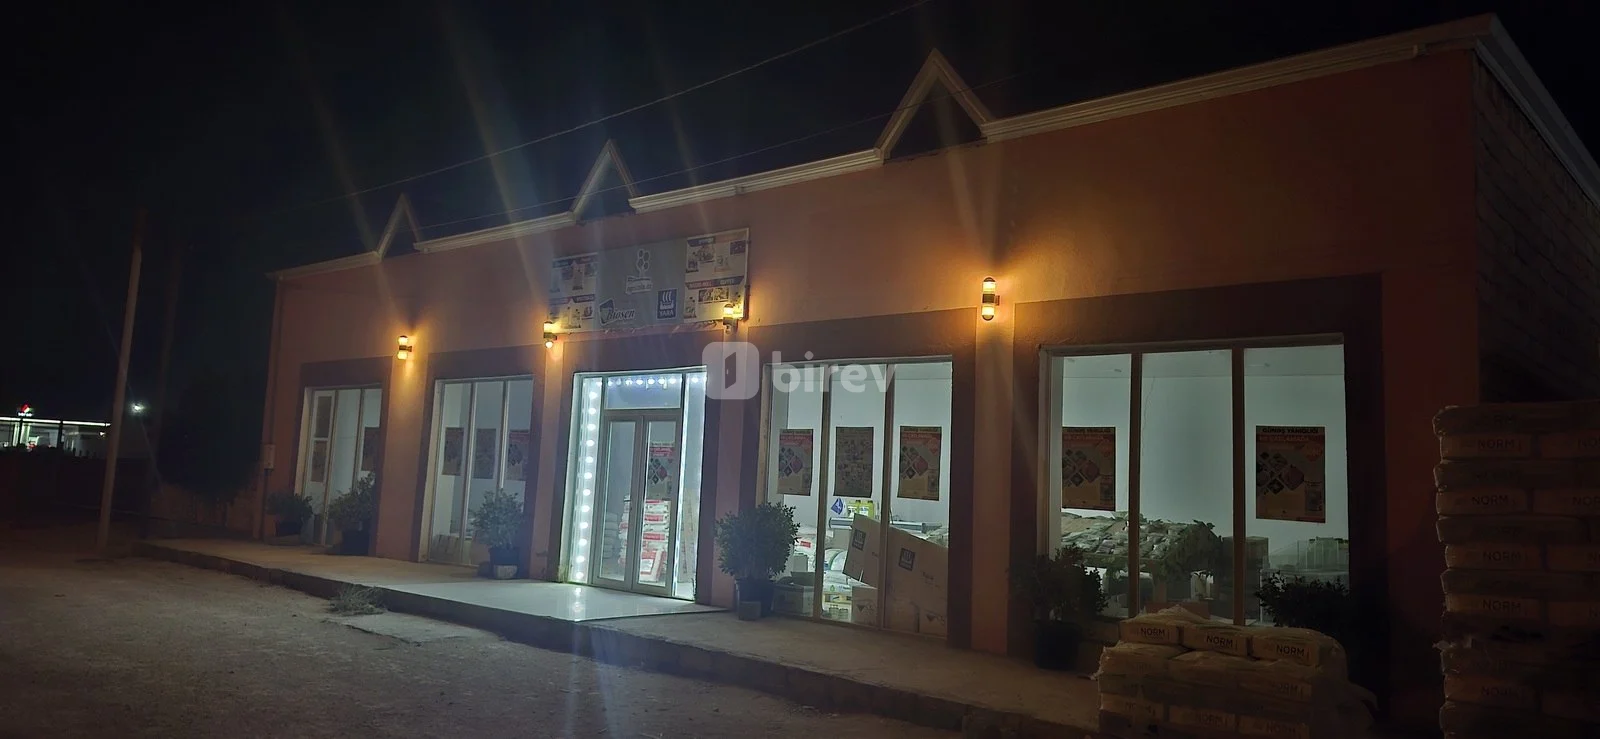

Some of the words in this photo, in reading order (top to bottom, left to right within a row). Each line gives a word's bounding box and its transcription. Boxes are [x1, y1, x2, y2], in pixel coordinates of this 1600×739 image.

[1478, 439, 1515, 449] NORM
[1471, 495, 1509, 505] NORM
[1572, 496, 1600, 506] NOR
[1482, 551, 1521, 561] NORM
[1482, 599, 1521, 612] NORM
[1140, 627, 1165, 637] NORM
[1206, 635, 1233, 648] NORM
[1276, 644, 1305, 657] NORM
